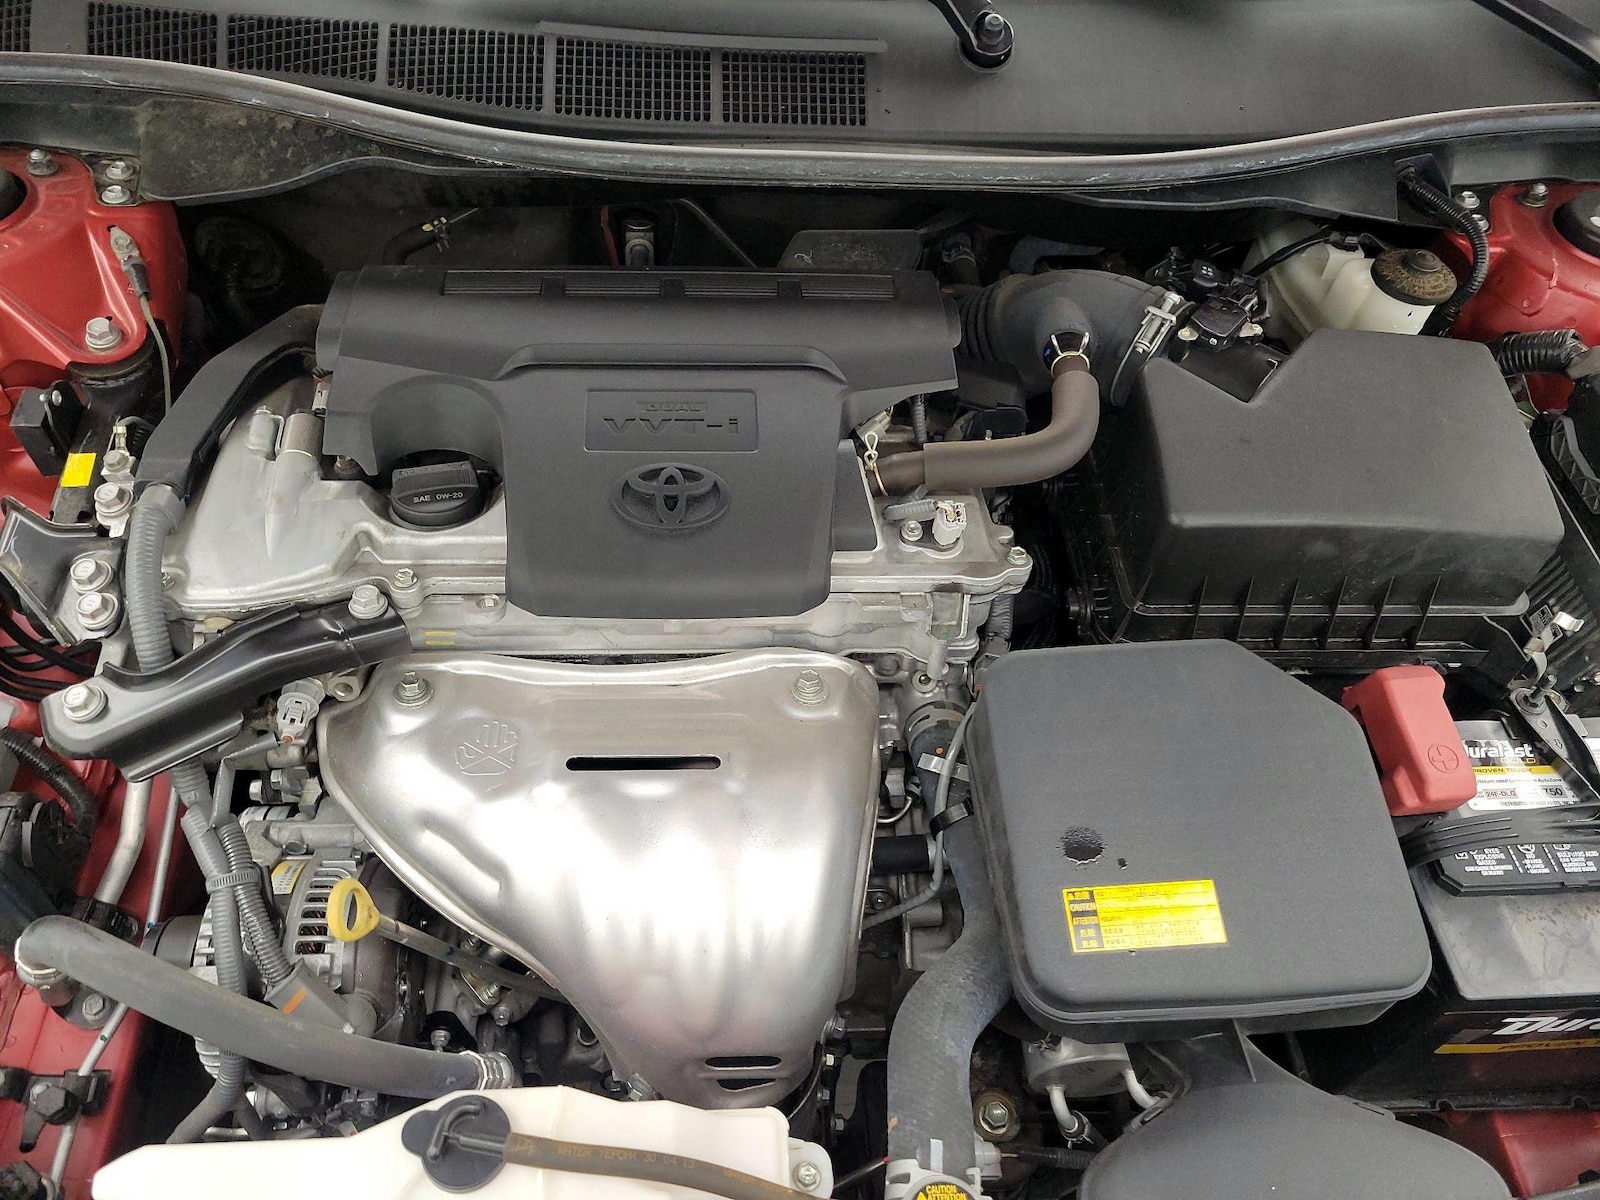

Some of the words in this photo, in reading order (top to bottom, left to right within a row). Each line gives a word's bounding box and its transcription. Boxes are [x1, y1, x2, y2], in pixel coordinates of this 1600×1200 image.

[644, 402, 704, 412] DUAL
[603, 418, 739, 434] VVT-i
[413, 495, 431, 503] SAE
[435, 491, 464, 500] 0W-20
[1543, 787, 1563, 796] 750
[925, 1184, 957, 1194] CAUTION
[927, 1192, 968, 1200] ATTENTION
